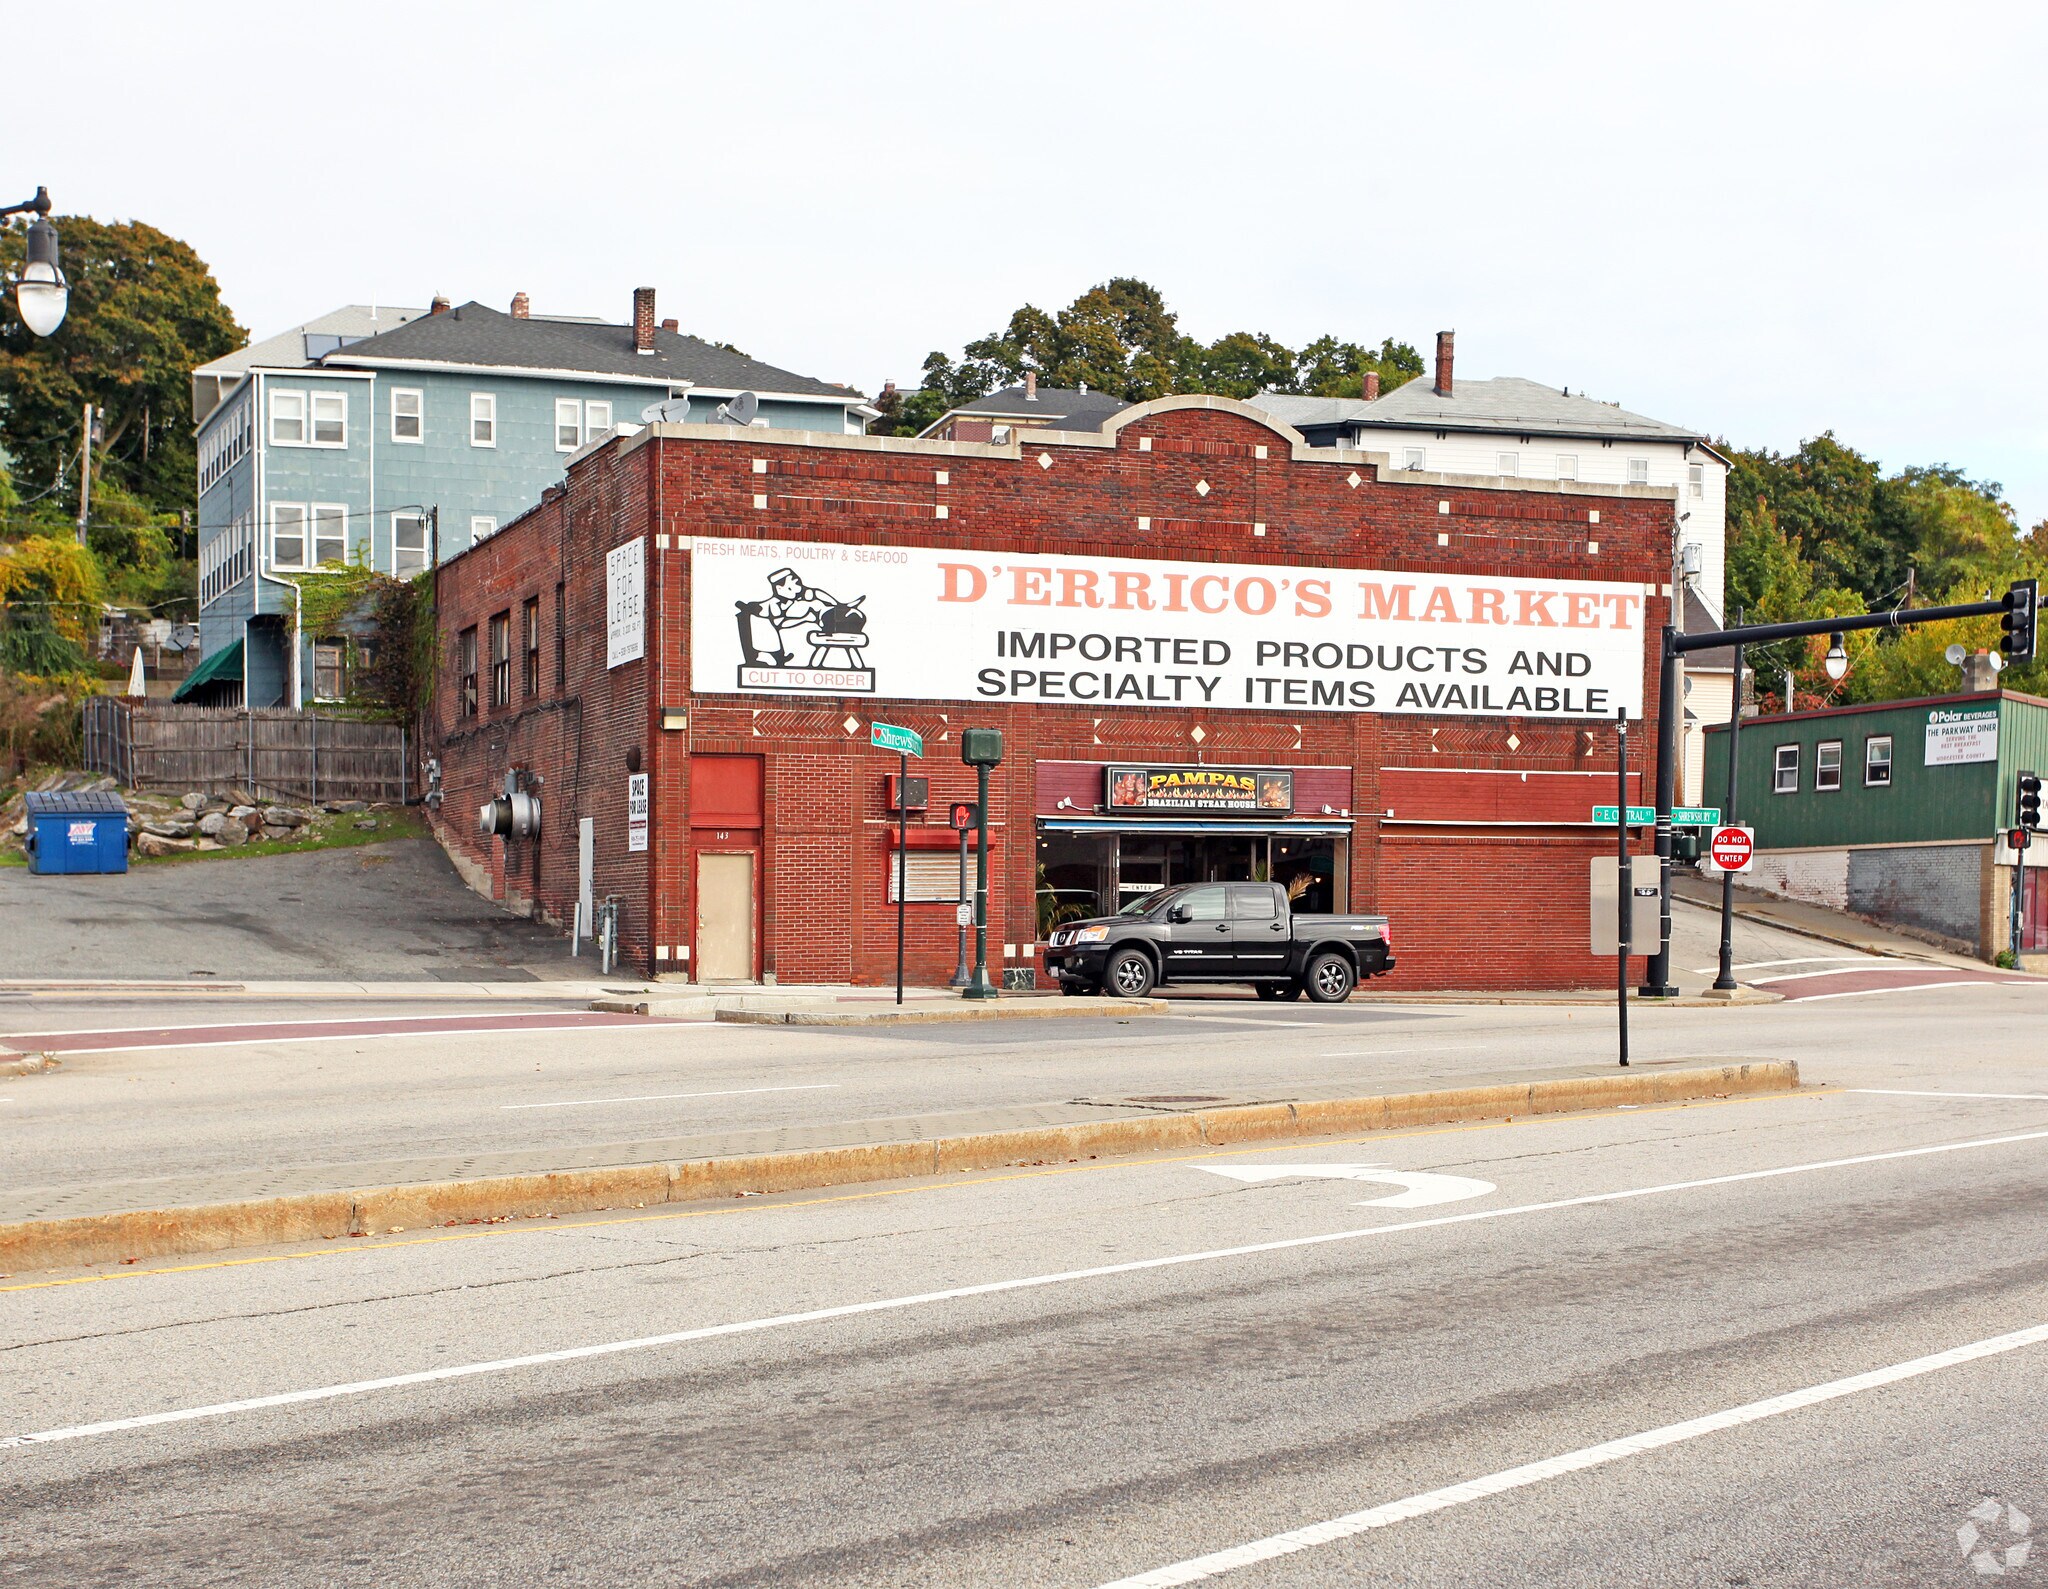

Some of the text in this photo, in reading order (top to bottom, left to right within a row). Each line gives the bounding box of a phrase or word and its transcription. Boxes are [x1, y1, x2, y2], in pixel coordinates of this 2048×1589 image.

[611, 544, 638, 576] SPACE
[696, 543, 908, 564] FRESH MEATS, POULTRY & SEAFOOD
[616, 572, 633, 598] FOR
[937, 562, 1640, 630] D'ERRICO'S MARKET
[611, 594, 638, 625] LEASE
[997, 630, 1592, 678] IMPORTED PRODUCTS AND
[749, 671, 865, 686] CUT TO ORDER
[976, 668, 1609, 714] SPECIALTY ITEMS AVAILABLE
[1938, 710, 1997, 723] Polar BEVERAGES
[1927, 723, 1997, 737] THE PARKWAY DINER
[632, 778, 645, 796] SPACE
[1149, 772, 1256, 791] PAMPAS
[1148, 799, 1256, 809] BRAZILIAN STEAK HOUSE
[1611, 810, 1645, 821] CTRAL
[1678, 811, 1711, 822] SHREWSBURY
[716, 831, 729, 840] 143
[1717, 835, 1746, 844] DO NOT
[1720, 854, 1743, 863] ENTER
